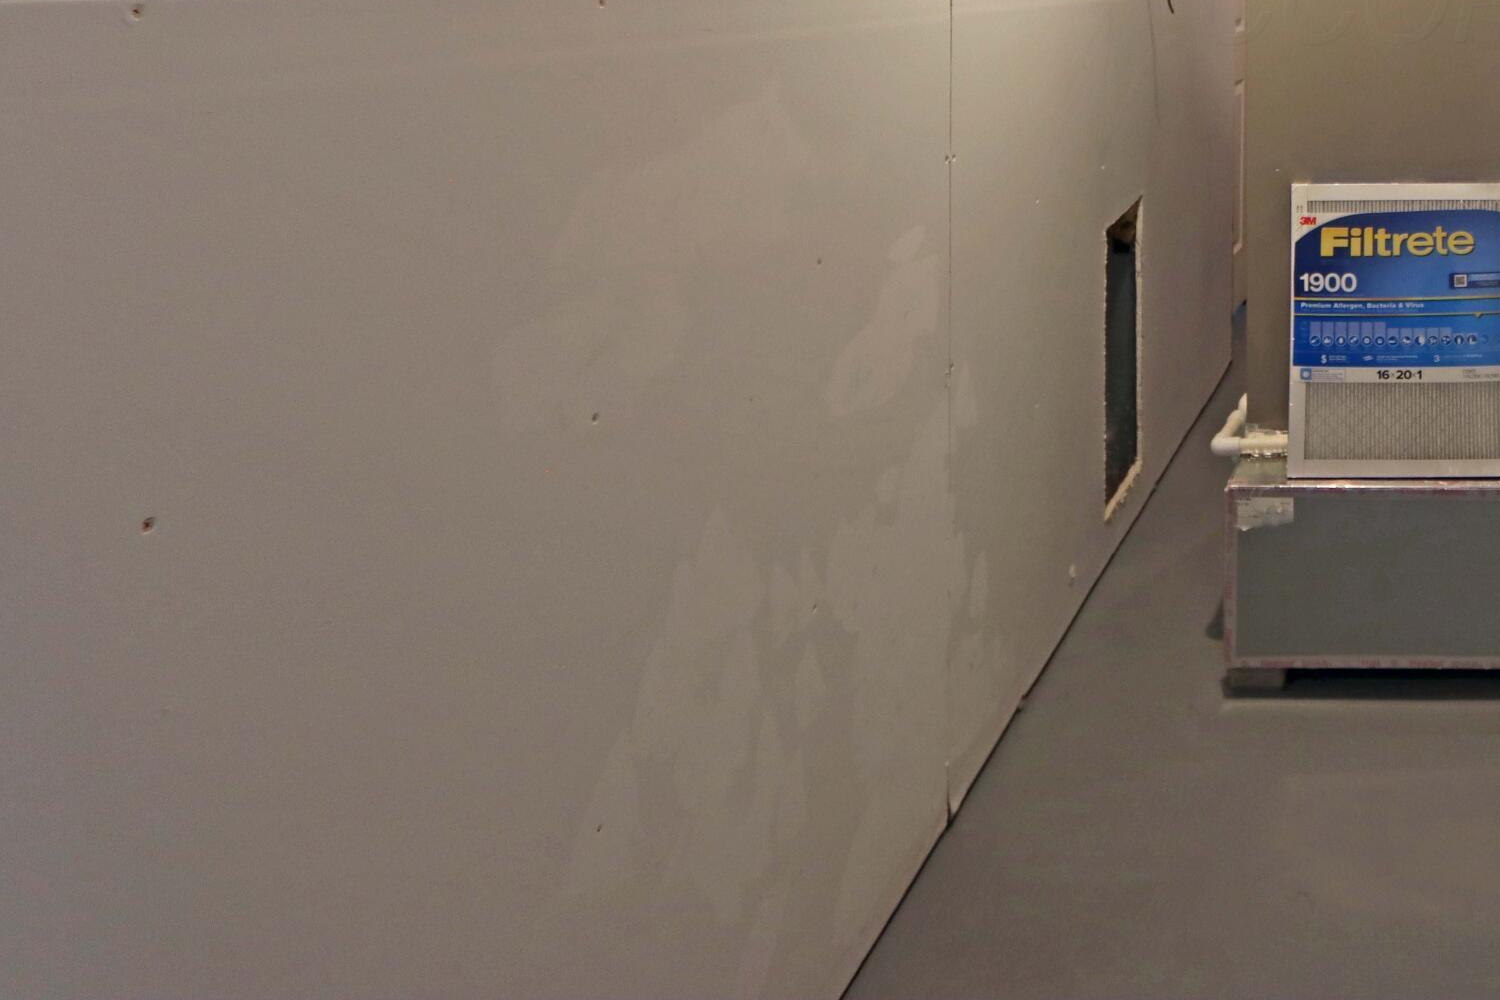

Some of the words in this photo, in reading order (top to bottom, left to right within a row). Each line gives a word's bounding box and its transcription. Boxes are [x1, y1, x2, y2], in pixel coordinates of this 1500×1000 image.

[1299, 216, 1317, 225] 3M
[1320, 226, 1476, 258] Filtrete
[1299, 272, 1358, 293] 1900
[1333, 302, 1365, 310] Allergen,
